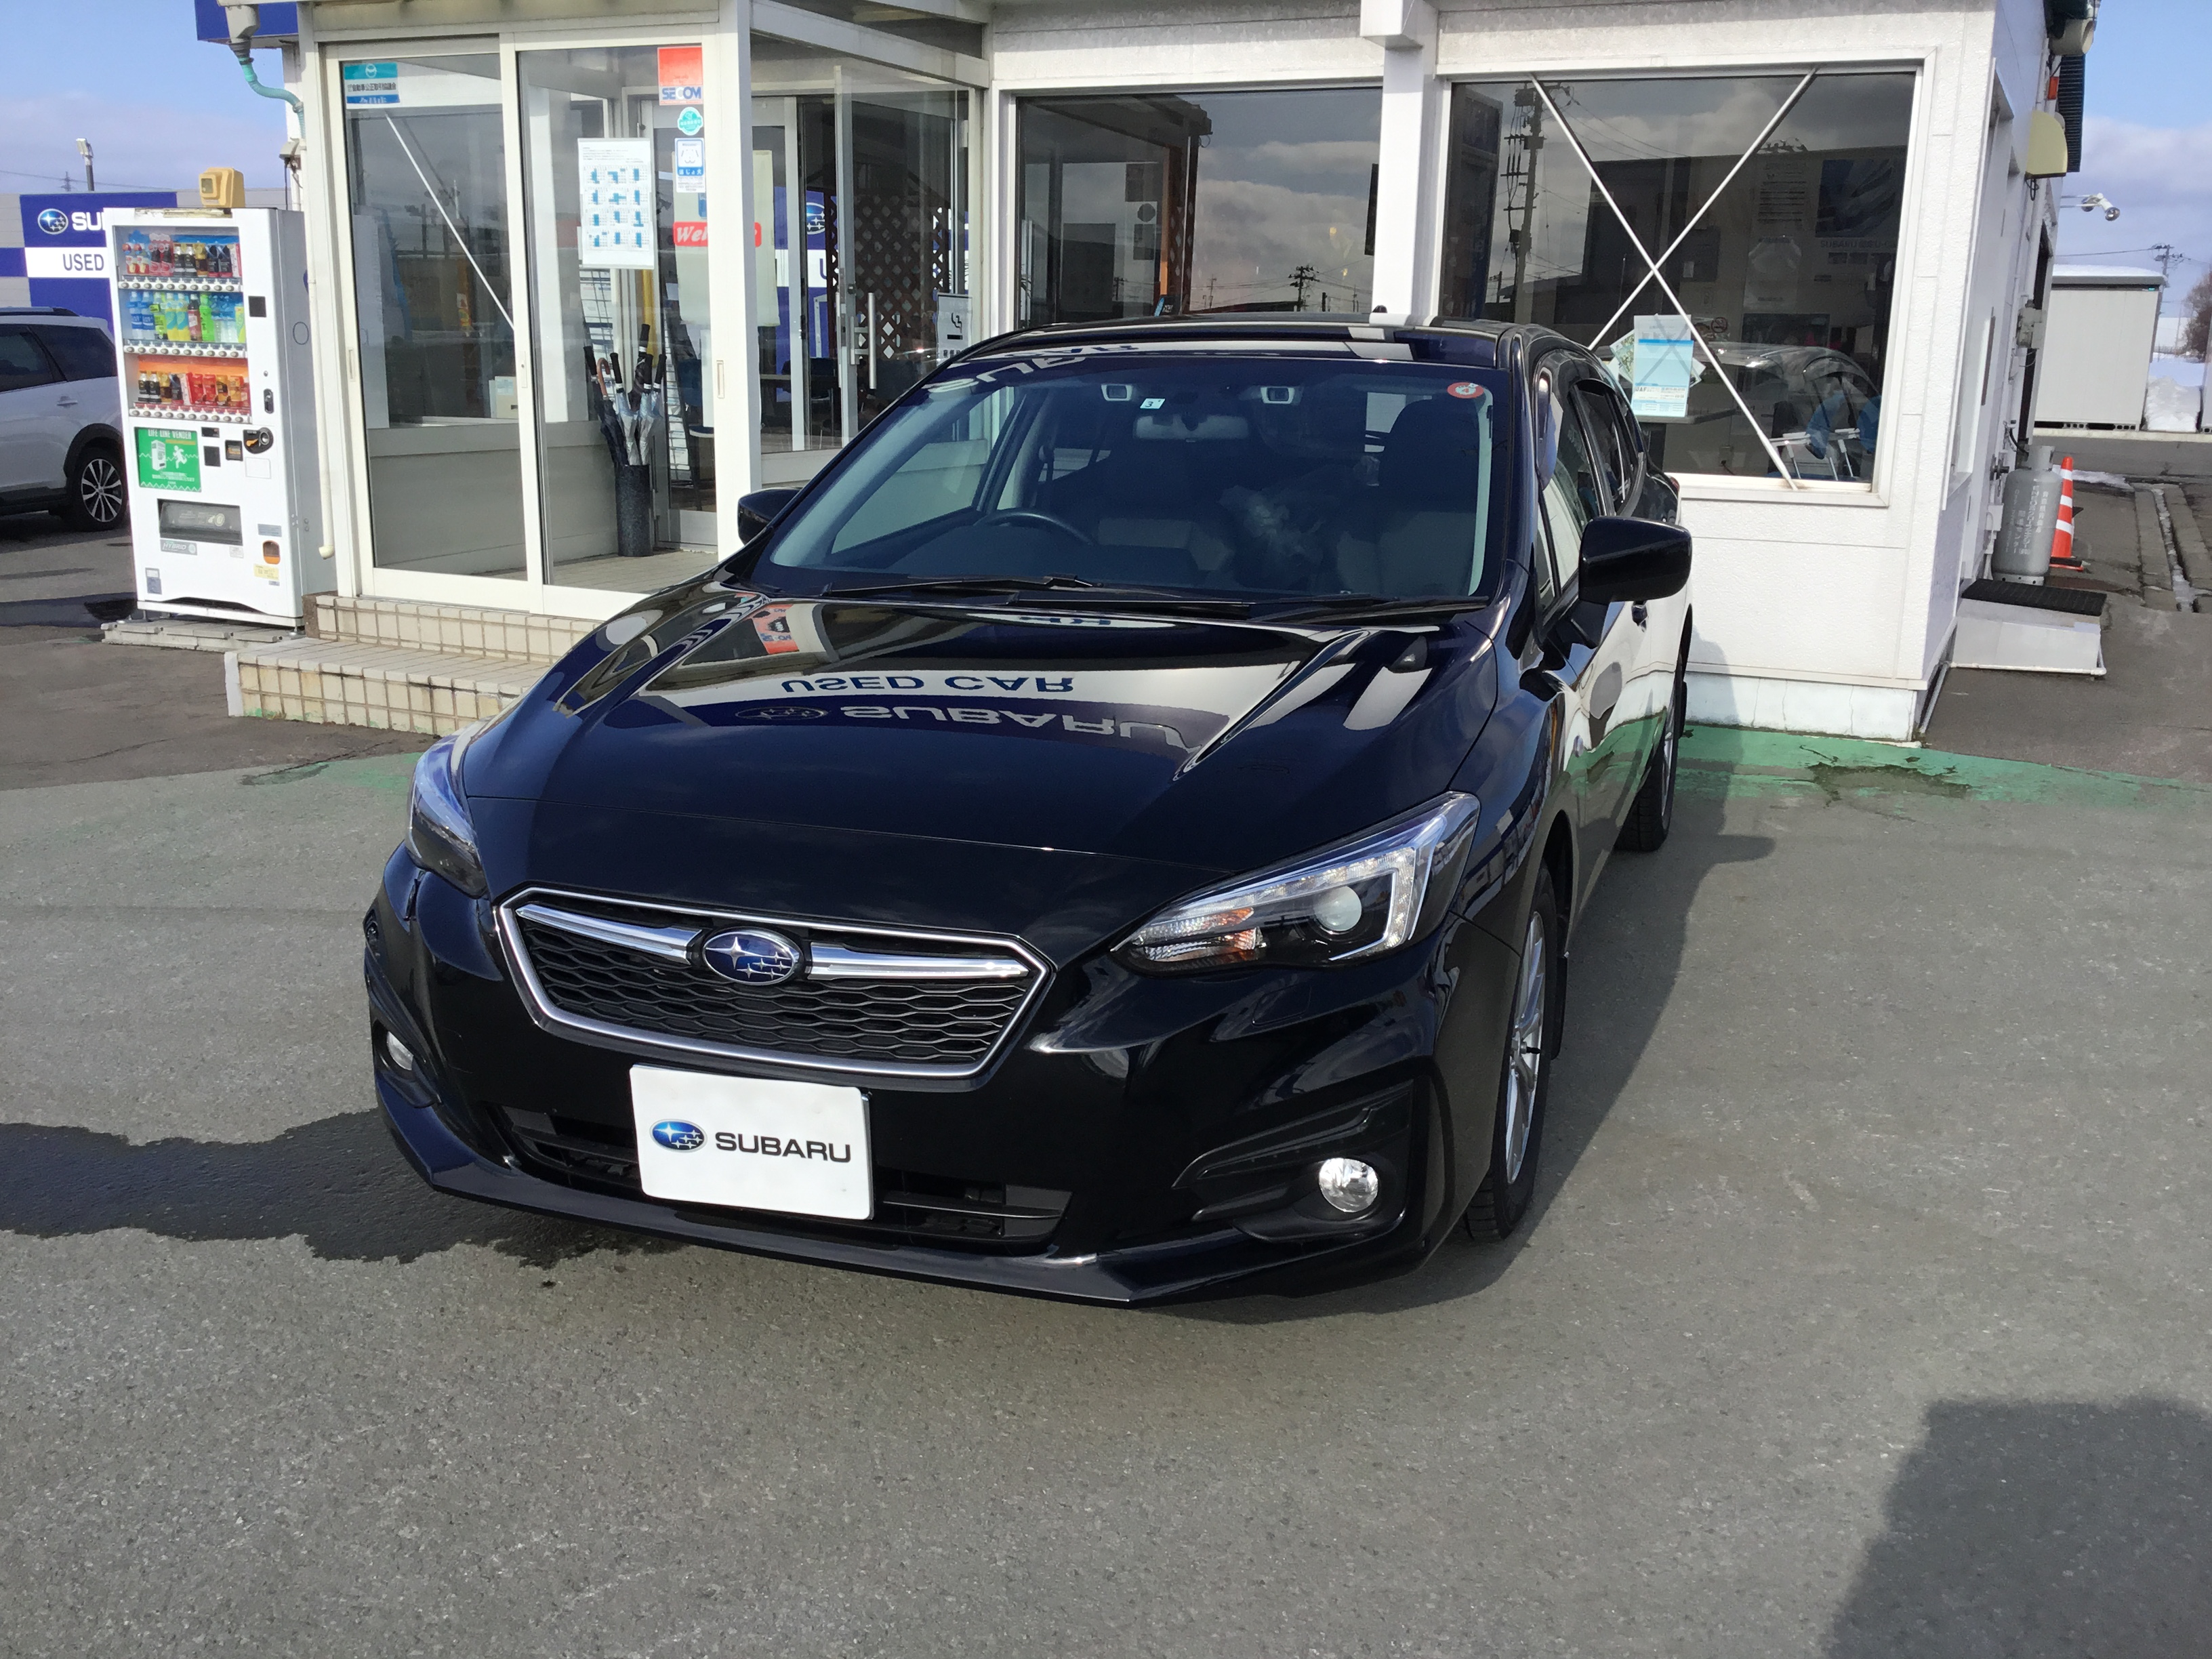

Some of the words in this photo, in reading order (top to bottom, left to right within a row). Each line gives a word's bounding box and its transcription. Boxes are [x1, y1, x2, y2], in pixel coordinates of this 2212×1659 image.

[661, 86, 701, 100] SECOM
[71, 211, 104, 231] SU
[62, 253, 104, 271] USED
[148, 429, 158, 437] LIFE
[159, 430, 171, 438] LINE
[172, 430, 192, 440] VENDER
[163, 542, 186, 551] HYBRID
[715, 1131, 852, 1164] SUBARU
